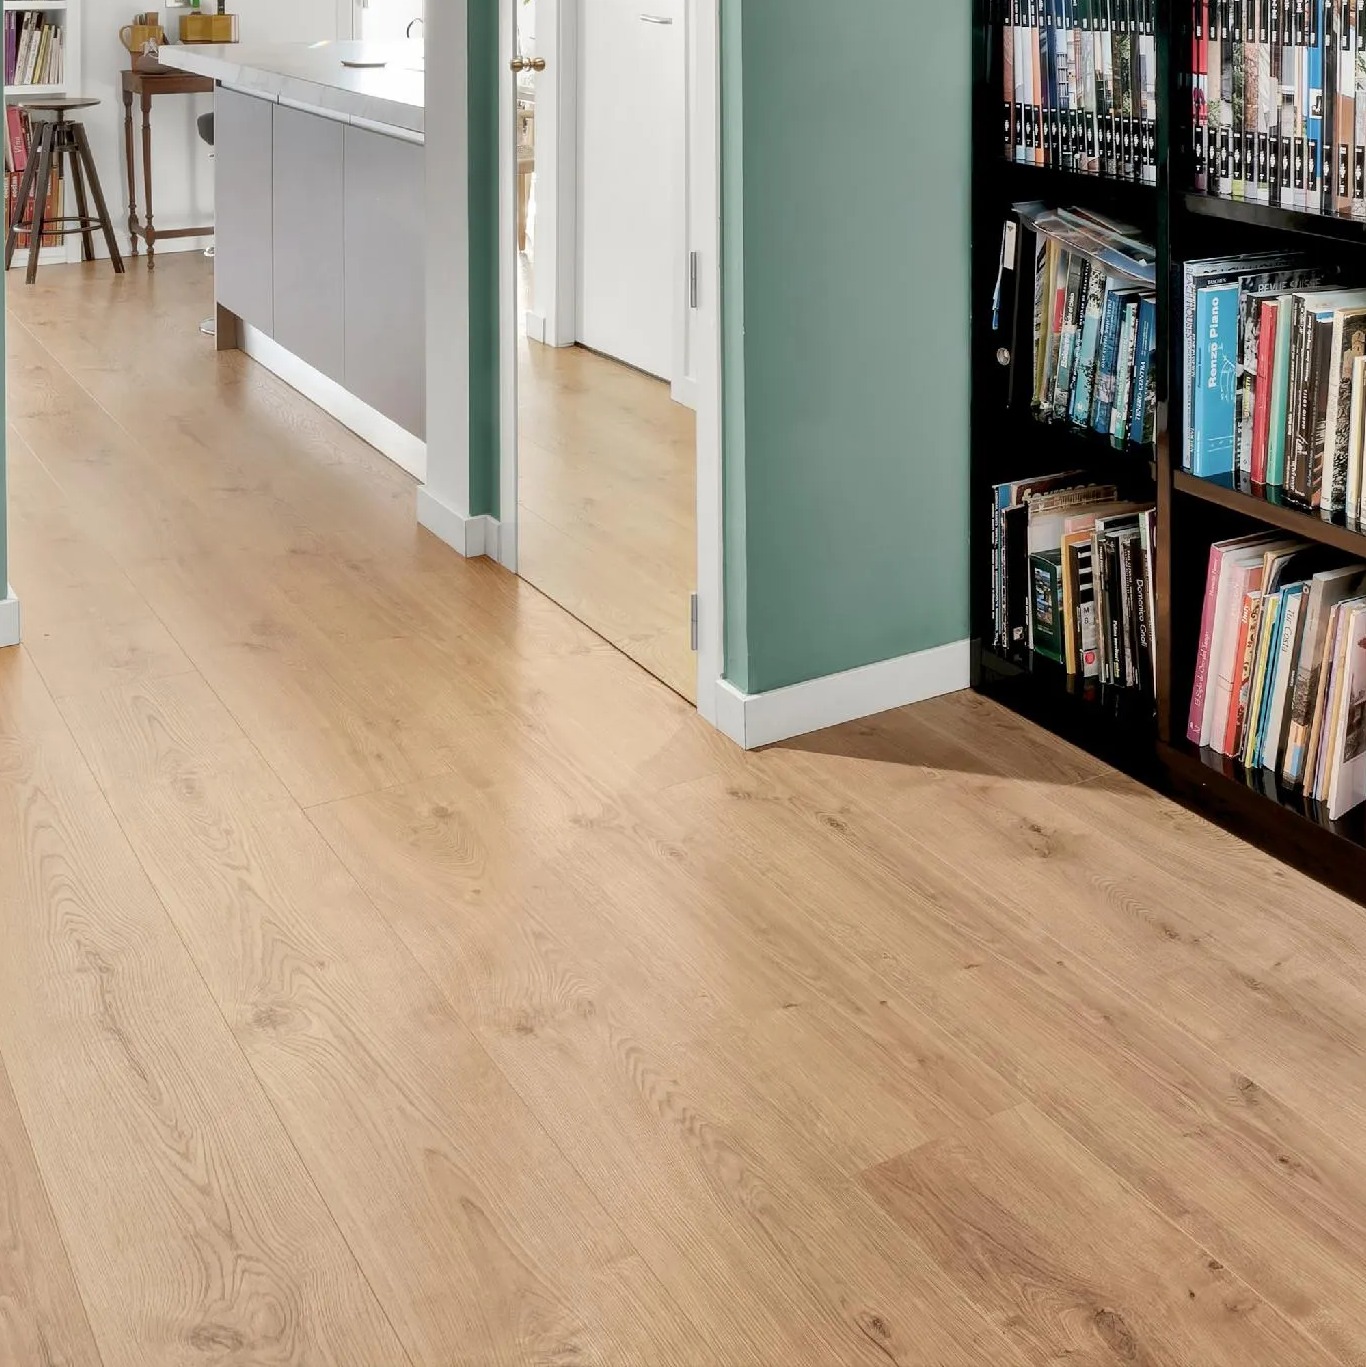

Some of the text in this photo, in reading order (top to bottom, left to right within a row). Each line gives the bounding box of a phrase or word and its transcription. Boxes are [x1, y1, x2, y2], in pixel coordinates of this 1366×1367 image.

[1207, 296, 1220, 388] Renzo Piano
[1136, 578, 1146, 622] Domenico
